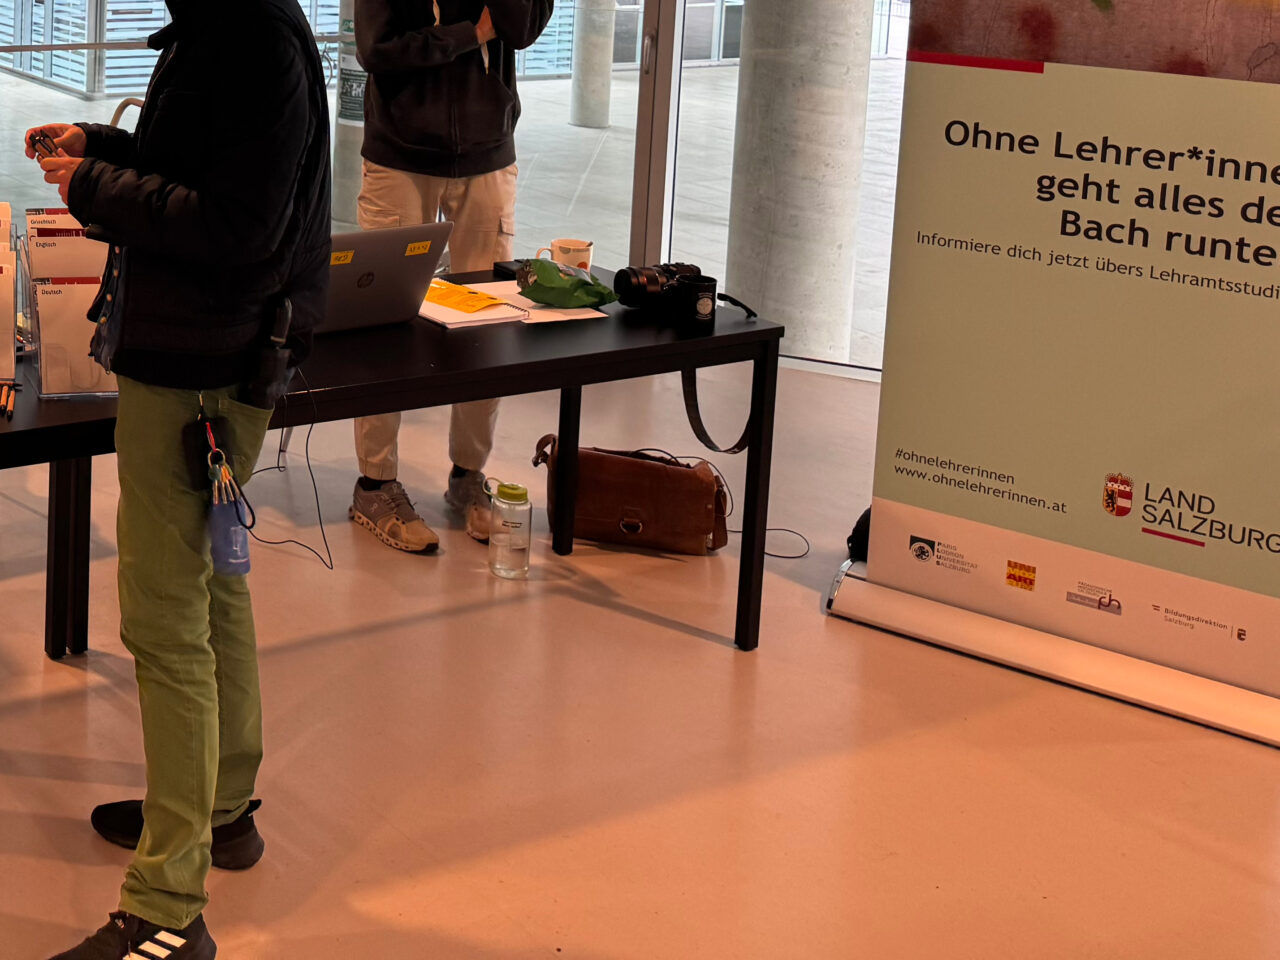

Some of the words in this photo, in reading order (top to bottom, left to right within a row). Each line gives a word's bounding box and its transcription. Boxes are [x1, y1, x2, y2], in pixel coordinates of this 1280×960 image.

[943, 119, 1040, 154] Ohne
[1036, 171, 1121, 204] geht
[1134, 183, 1224, 218] alles
[1060, 209, 1150, 248] Bach
[916, 230, 1002, 255] Informiere
[1006, 242, 1042, 263] dich
[1046, 248, 1090, 270] jetzt
[1095, 257, 1143, 277] übers
[894, 447, 1015, 485] #ohnelehrerinnen
[894, 465, 1067, 514] www.ohnelehrerinnen.at
[1144, 482, 1216, 515] LAND
[1142, 504, 1280, 553] SALZBURG
[1164, 607, 1228, 630] Bildungsdirektion
